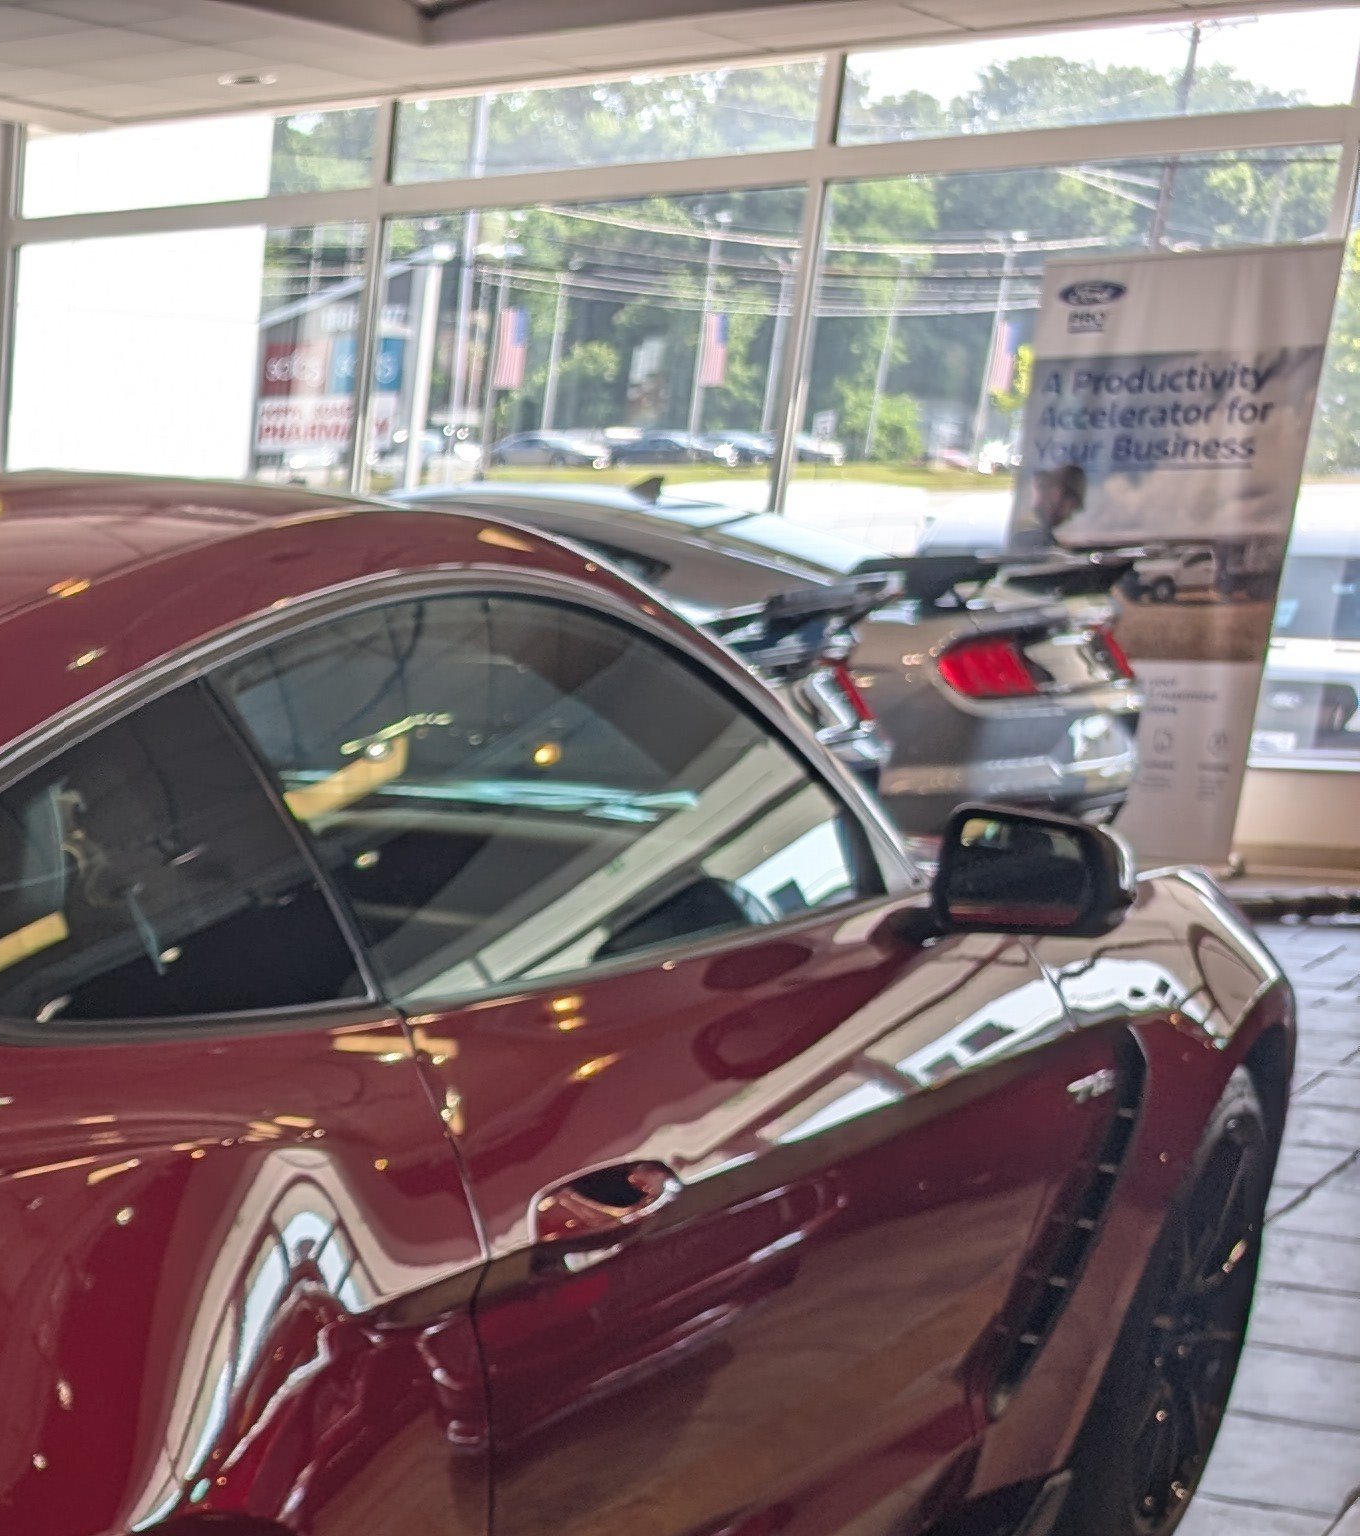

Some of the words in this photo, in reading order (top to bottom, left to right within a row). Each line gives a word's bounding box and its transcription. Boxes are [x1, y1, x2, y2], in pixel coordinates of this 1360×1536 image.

[1042, 370, 1063, 394] A
[1073, 363, 1270, 394] Productivity
[1042, 402, 1216, 429] Accelerator
[1228, 398, 1273, 425] for
[1034, 438, 1102, 465] Your
[1114, 433, 1256, 461] Business
